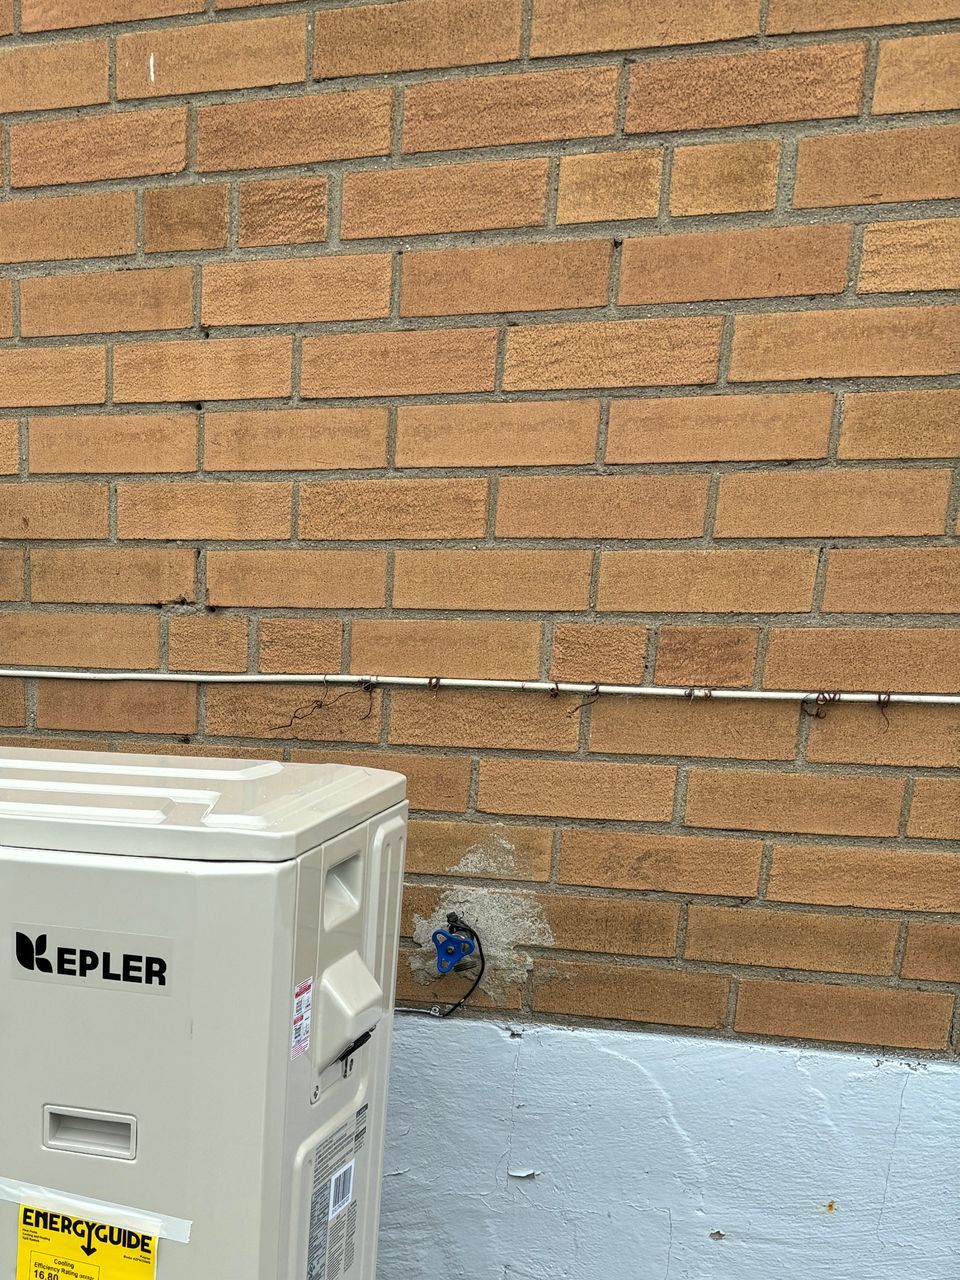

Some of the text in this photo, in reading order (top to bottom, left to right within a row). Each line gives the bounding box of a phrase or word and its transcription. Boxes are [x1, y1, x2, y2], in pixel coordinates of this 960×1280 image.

[15, 931, 167, 986] KEPLER
[22, 1207, 152, 1255] ENERGYGUIDE
[34, 1261, 61, 1274] Efficiency
[61, 1265, 78, 1279] Rating
[53, 1258, 75, 1270] Cooling
